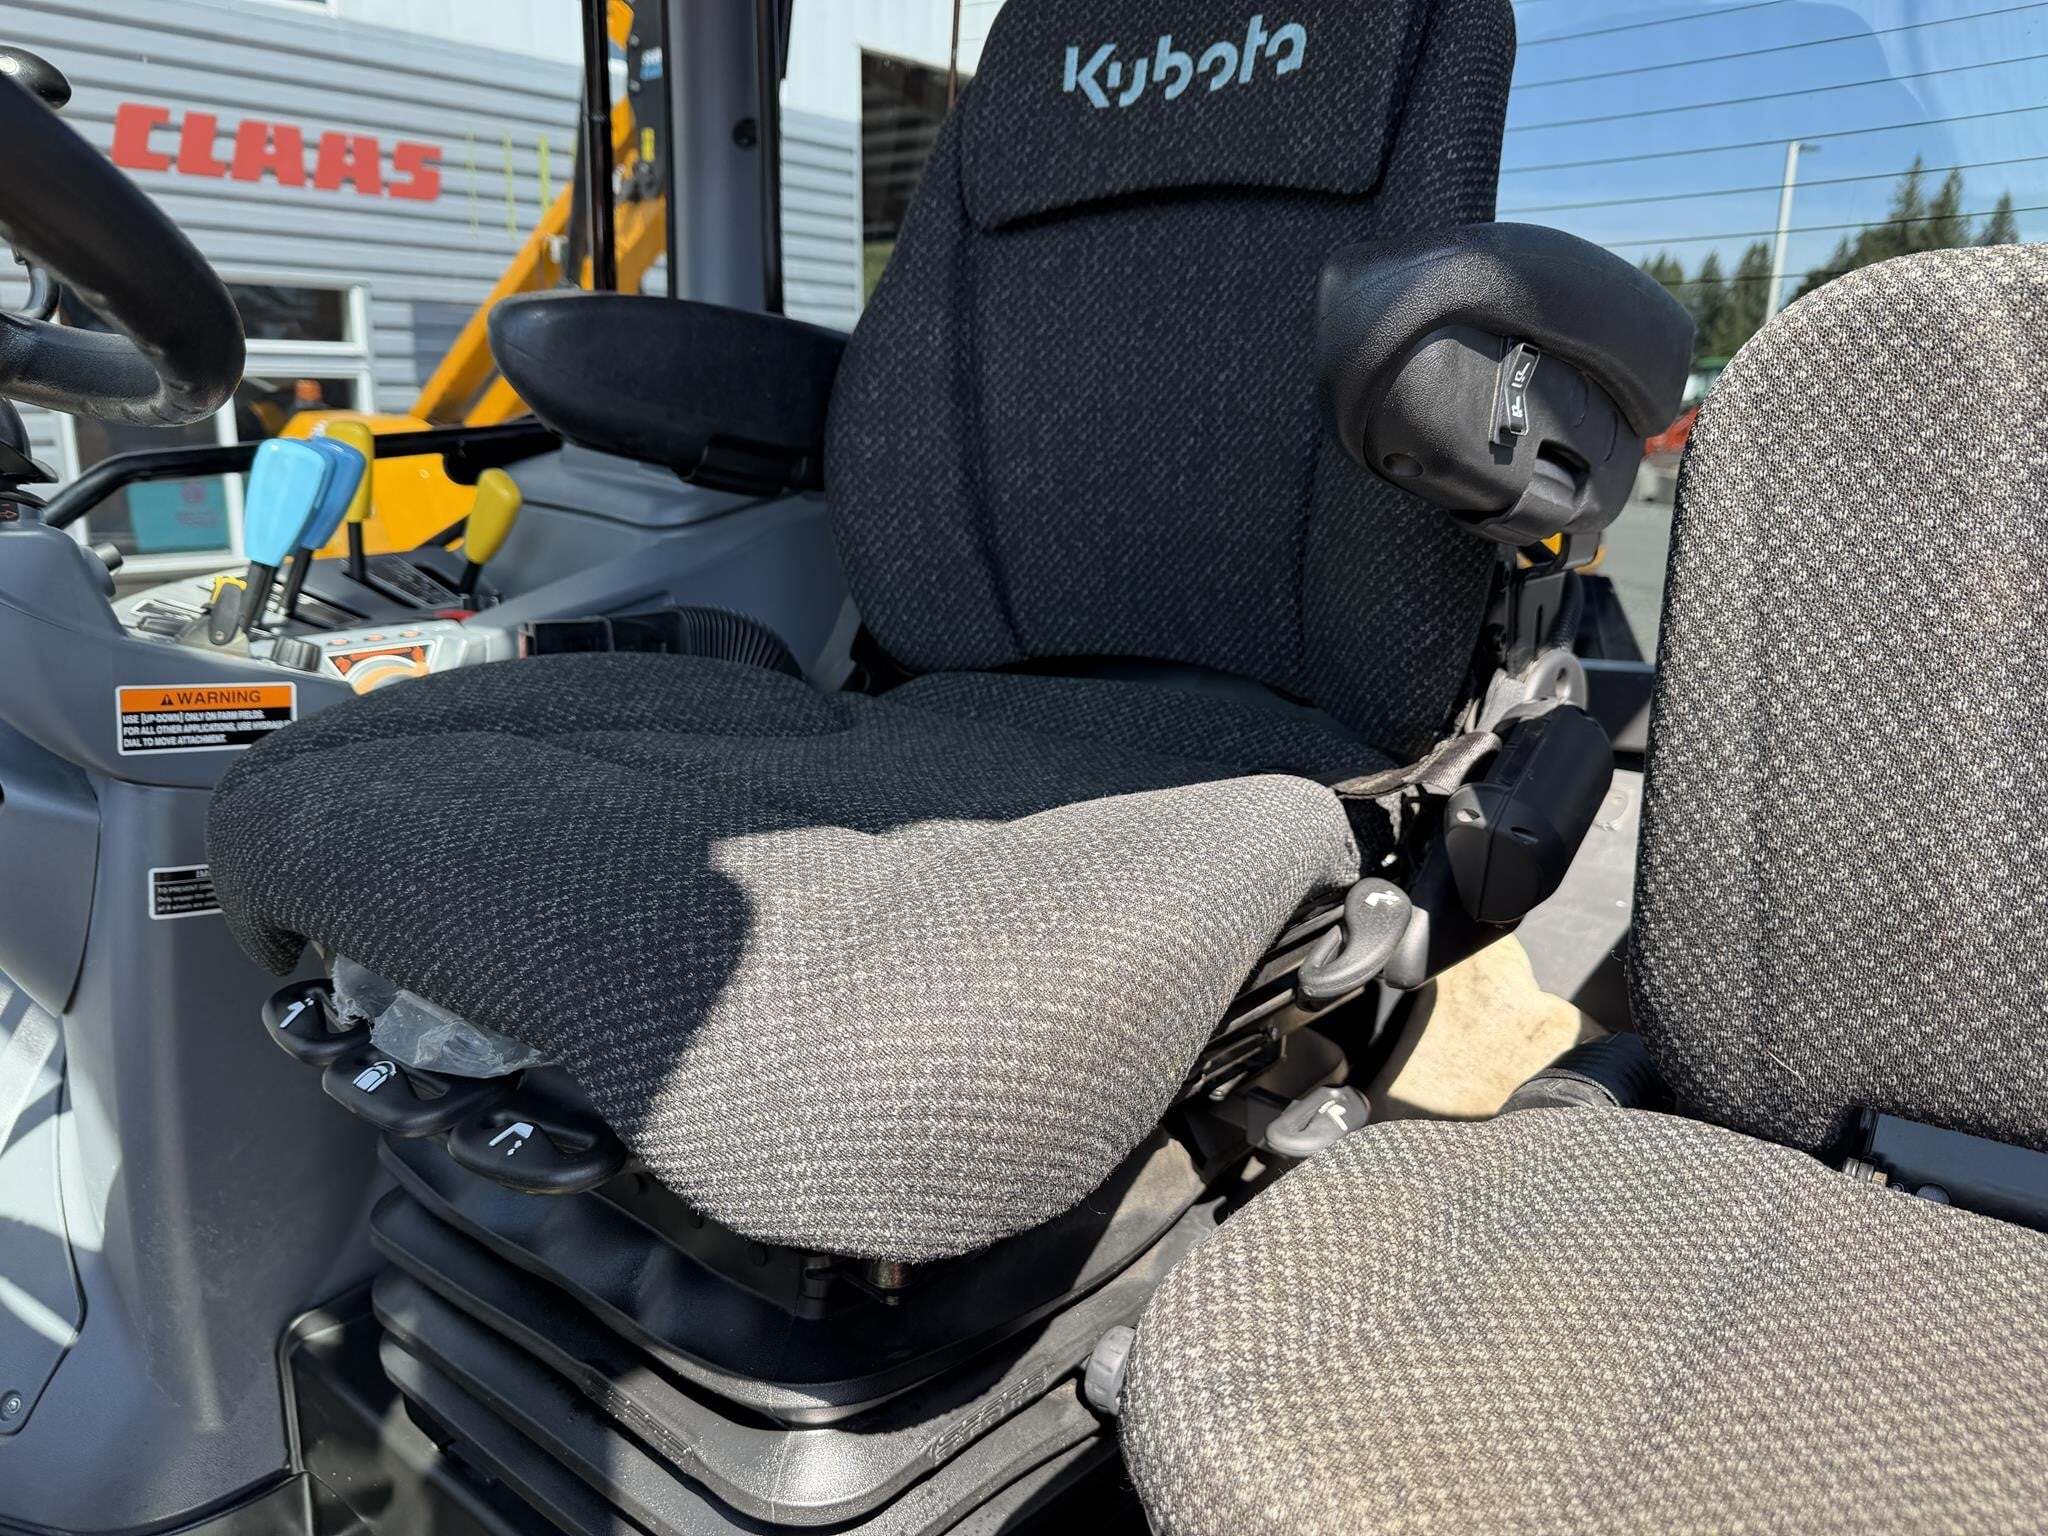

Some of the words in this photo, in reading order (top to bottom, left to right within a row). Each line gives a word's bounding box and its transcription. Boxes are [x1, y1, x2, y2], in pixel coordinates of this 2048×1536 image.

[1063, 14, 1307, 108] Kubota
[112, 103, 442, 202] CLAAS
[177, 691, 261, 705] WARNING
[123, 714, 139, 724] USE
[185, 712, 204, 722] ONLY
[205, 712, 216, 721] ON
[123, 726, 140, 736] FOR
[141, 725, 156, 735] ALL
[156, 724, 183, 734] OTHER
[237, 721, 251, 731] USE
[124, 738, 142, 748] DIAL
[143, 737, 153, 747] TO
[155, 736, 177, 746] MOVE
